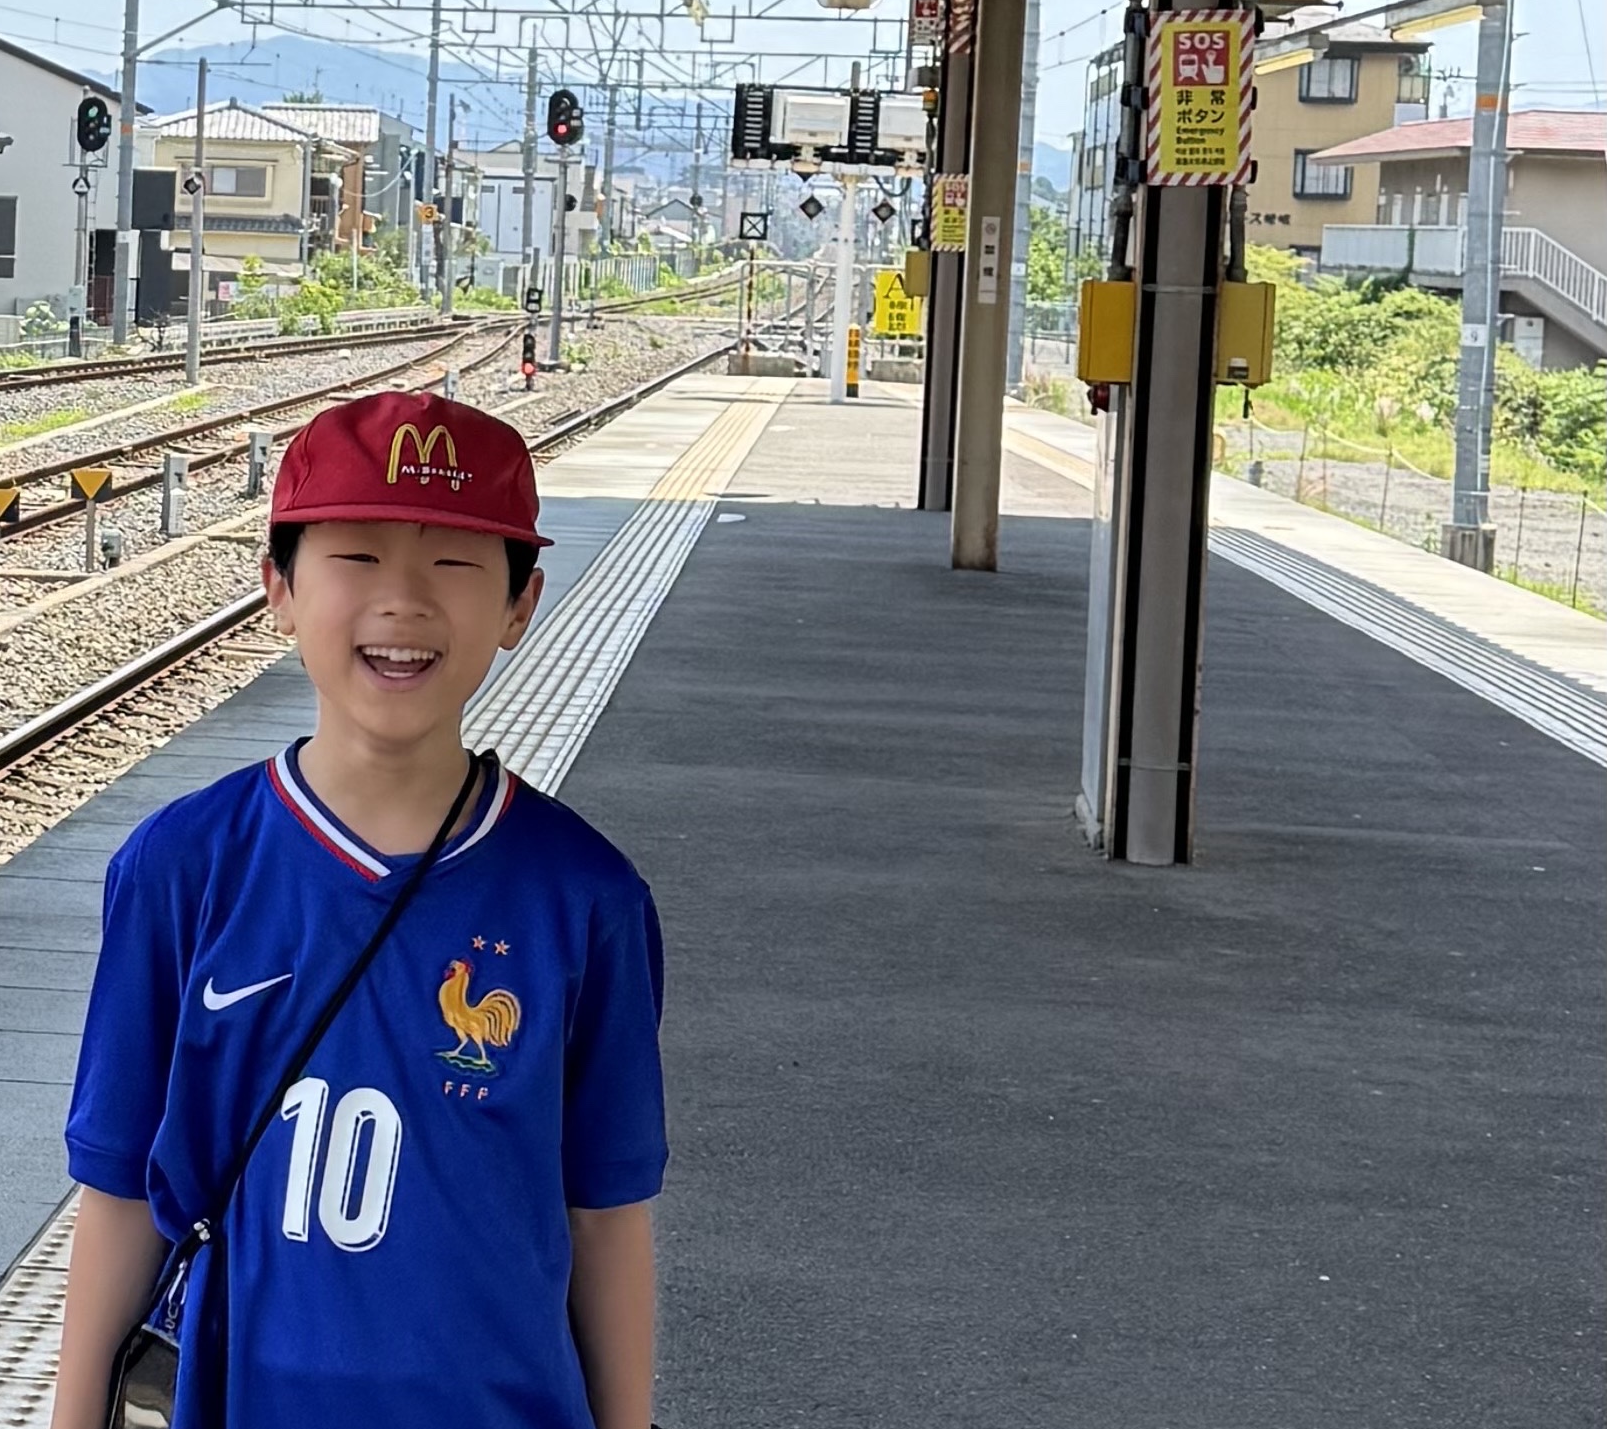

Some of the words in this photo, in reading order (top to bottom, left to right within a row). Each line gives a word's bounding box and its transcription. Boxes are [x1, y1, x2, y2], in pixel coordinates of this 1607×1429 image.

[1178, 32, 1225, 50] SOS
[1176, 109, 1225, 124] ボタン
[280, 1076, 403, 1253] 10
